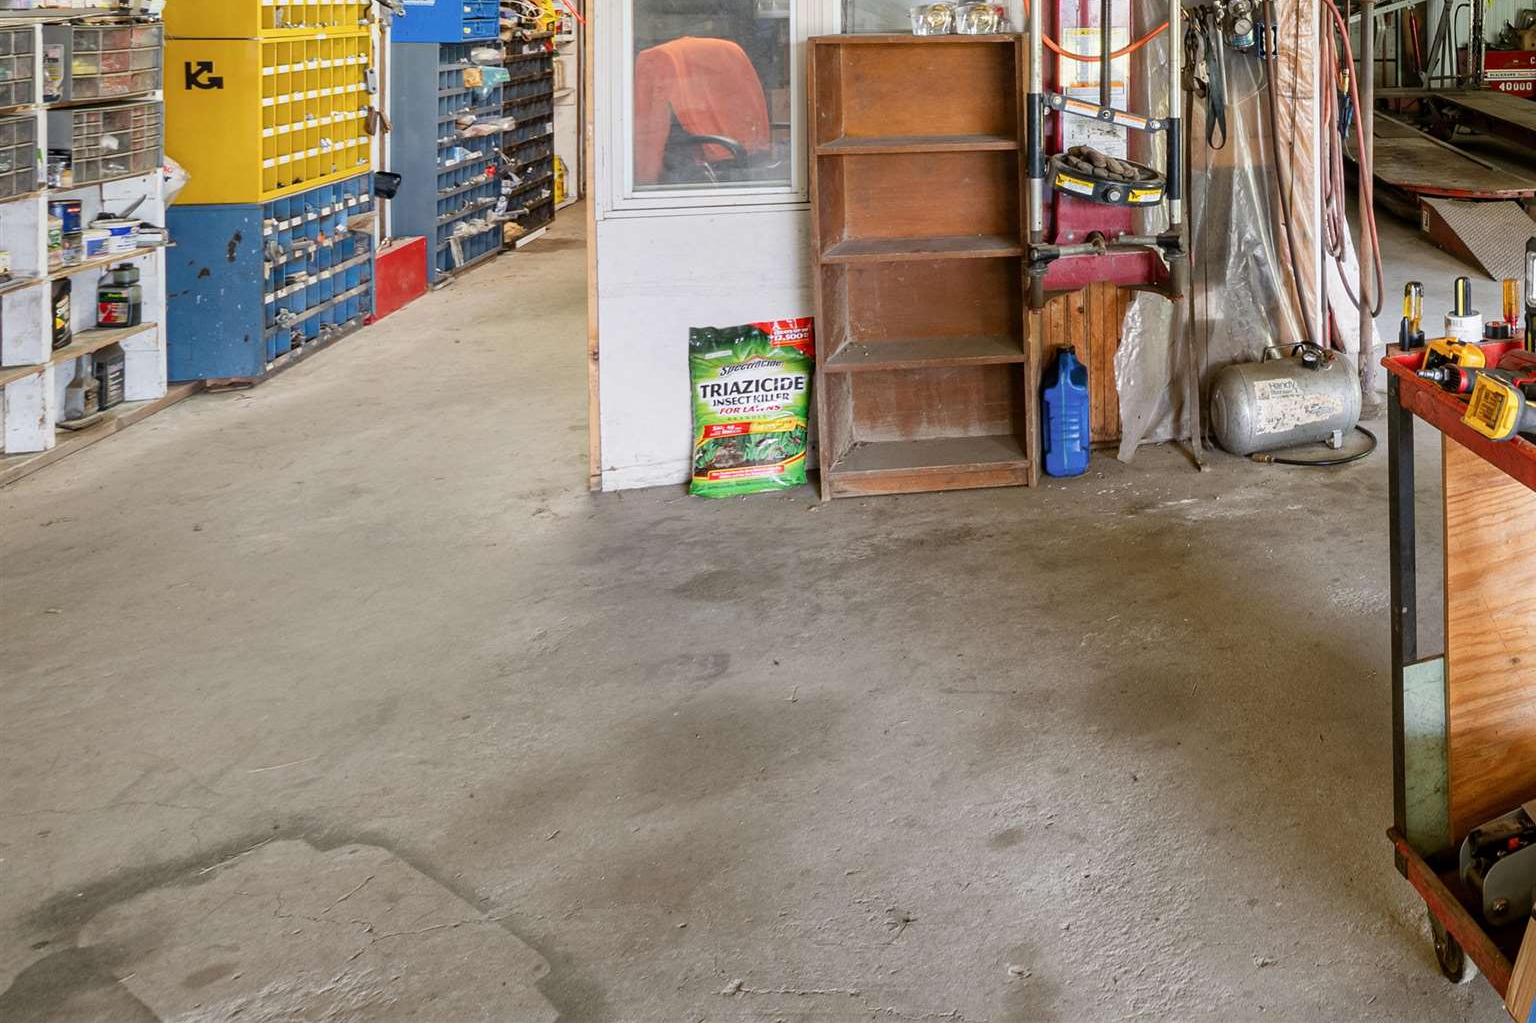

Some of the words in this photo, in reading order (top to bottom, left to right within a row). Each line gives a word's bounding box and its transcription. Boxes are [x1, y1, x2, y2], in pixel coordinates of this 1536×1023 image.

[1498, 81, 1533, 92] 40000
[700, 376, 804, 399] TRIAZICIDE
[712, 395, 750, 407] INSECT
[753, 392, 790, 404] KILLER
[720, 406, 741, 415] FOR
